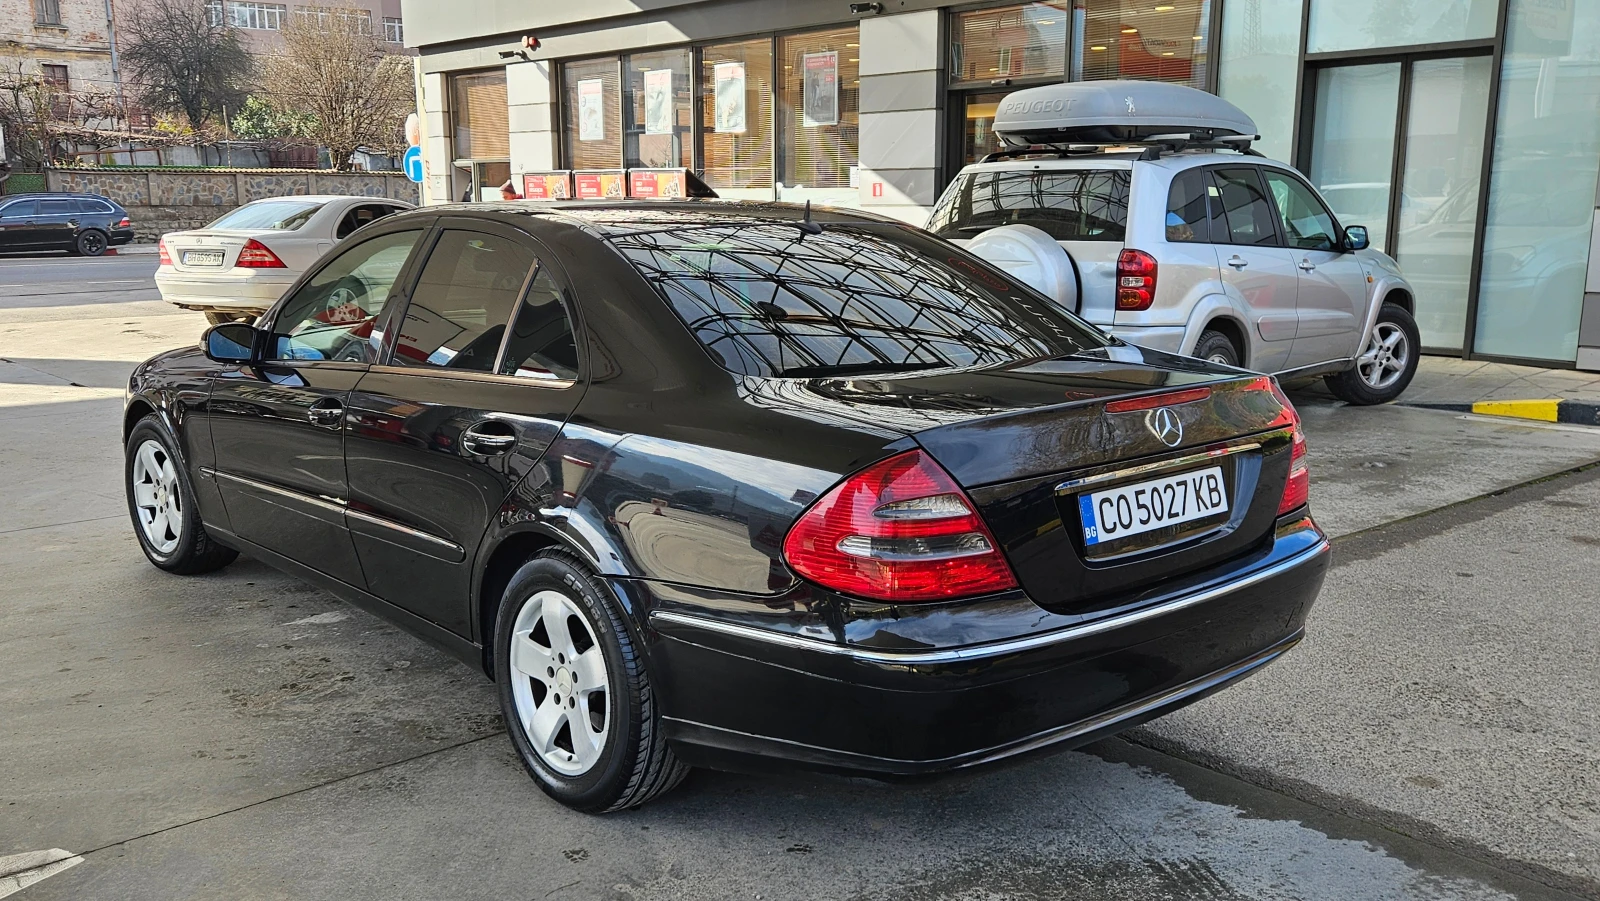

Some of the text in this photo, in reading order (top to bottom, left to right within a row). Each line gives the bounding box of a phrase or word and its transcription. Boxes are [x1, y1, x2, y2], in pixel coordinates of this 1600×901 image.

[1004, 99, 1076, 115] PEUGEOT
[1099, 474, 1222, 534] CO 5027 KB
[1085, 526, 1097, 539] BG
